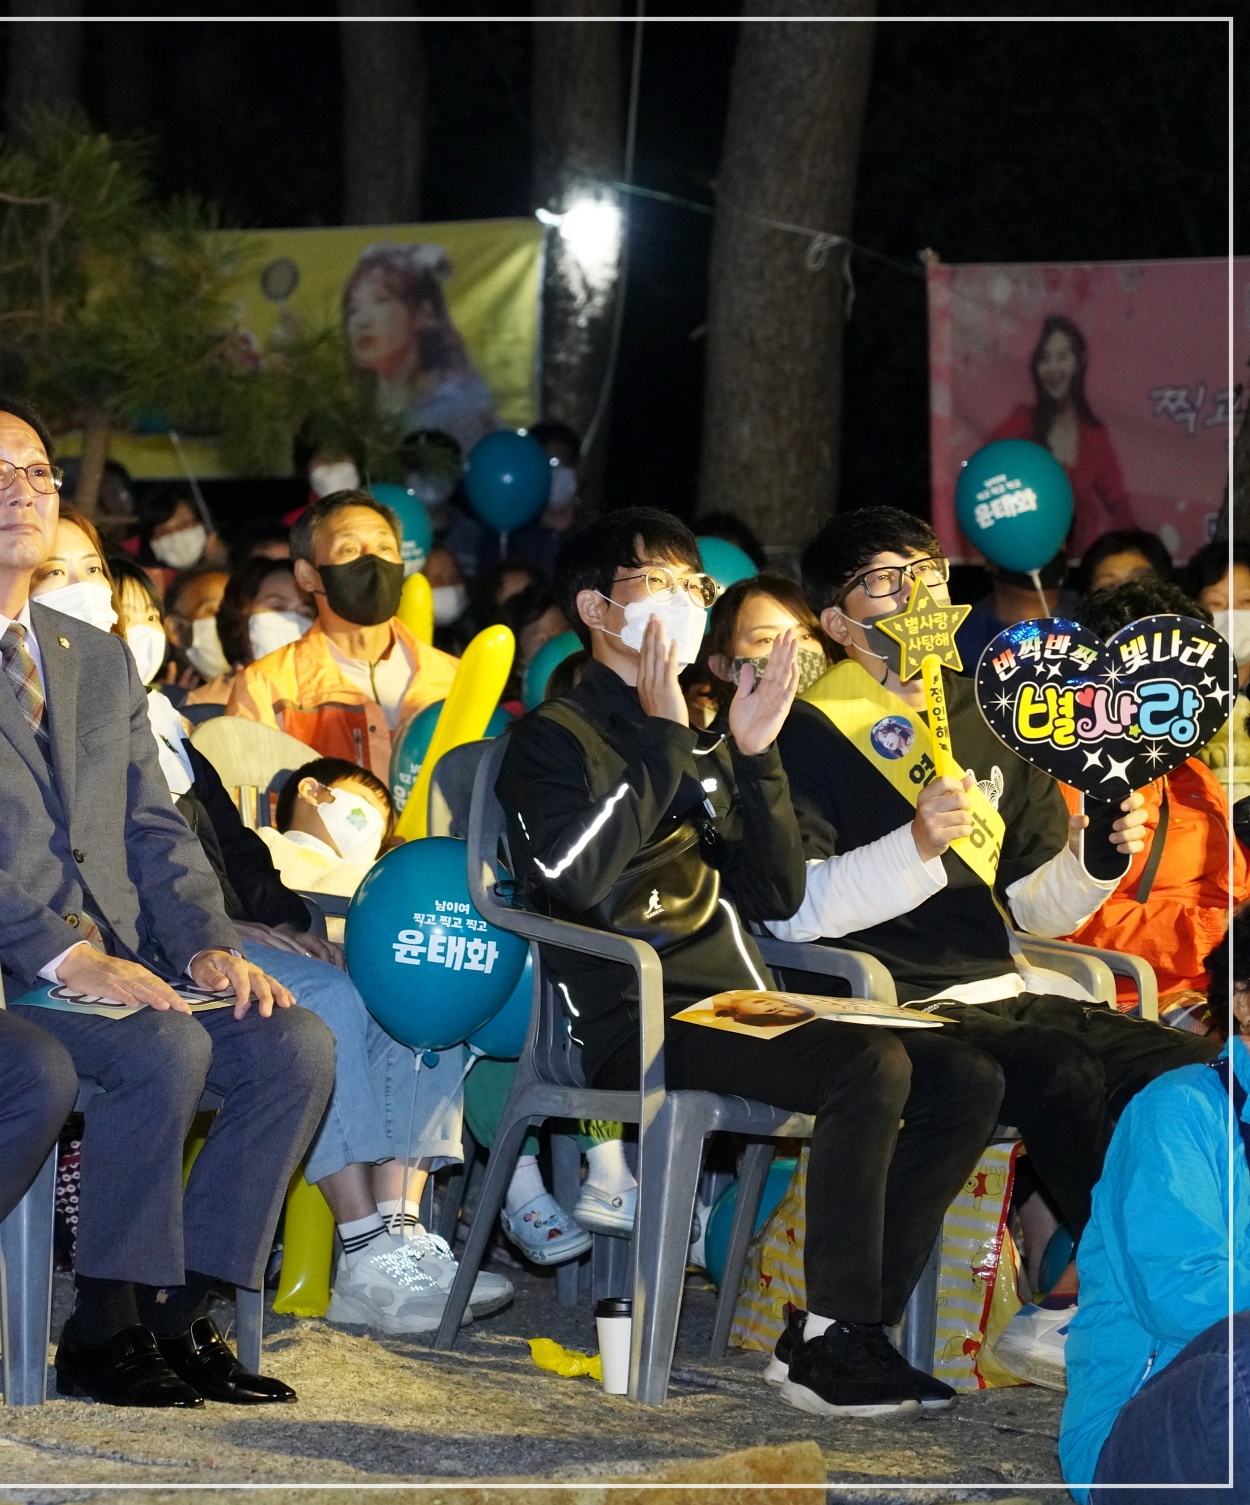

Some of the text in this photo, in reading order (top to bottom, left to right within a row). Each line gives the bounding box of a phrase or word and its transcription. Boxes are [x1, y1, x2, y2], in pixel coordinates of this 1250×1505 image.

[974, 487, 1038, 529] 윤태화
[904, 611, 949, 635] 별사랑
[907, 632, 950, 652] 사탕해
[992, 628, 1217, 682] 반짝반짝 빛나라
[1015, 681, 1202, 748] 별사랑
[413, 912, 488, 932] 찍고 찍고 찍고
[434, 899, 470, 915] 님이여
[392, 929, 499, 974] 윤태화
